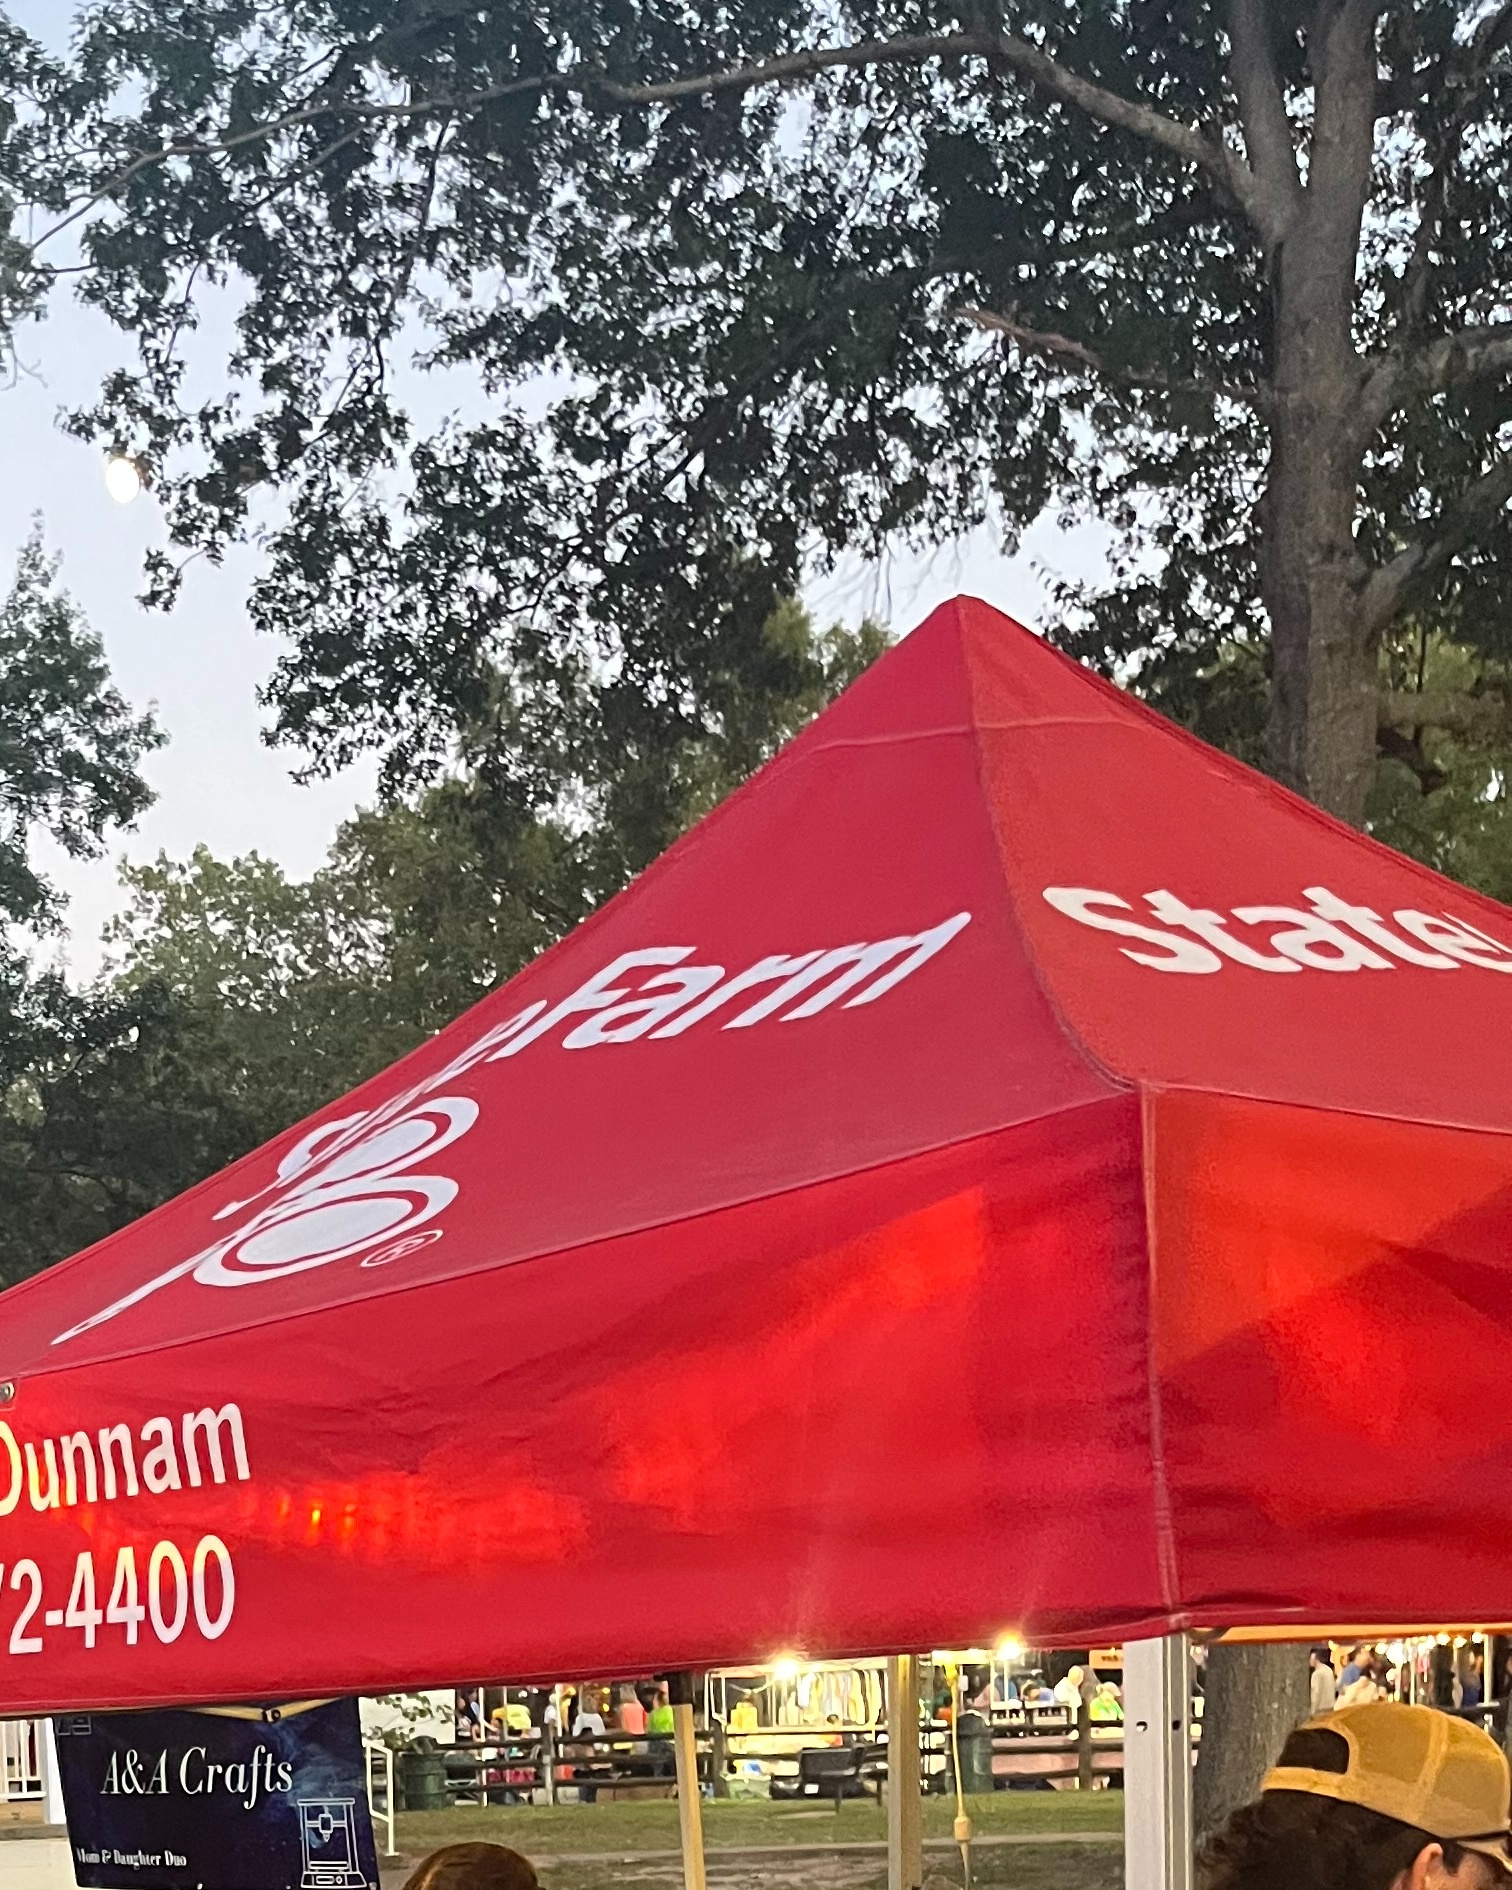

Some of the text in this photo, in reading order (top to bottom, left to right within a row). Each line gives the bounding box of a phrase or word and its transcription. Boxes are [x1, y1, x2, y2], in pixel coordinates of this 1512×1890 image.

[99, 1744, 294, 1810] A&A Crafts
[113, 1849, 162, 1871] Daughter
[164, 1850, 187, 1867] Duo
